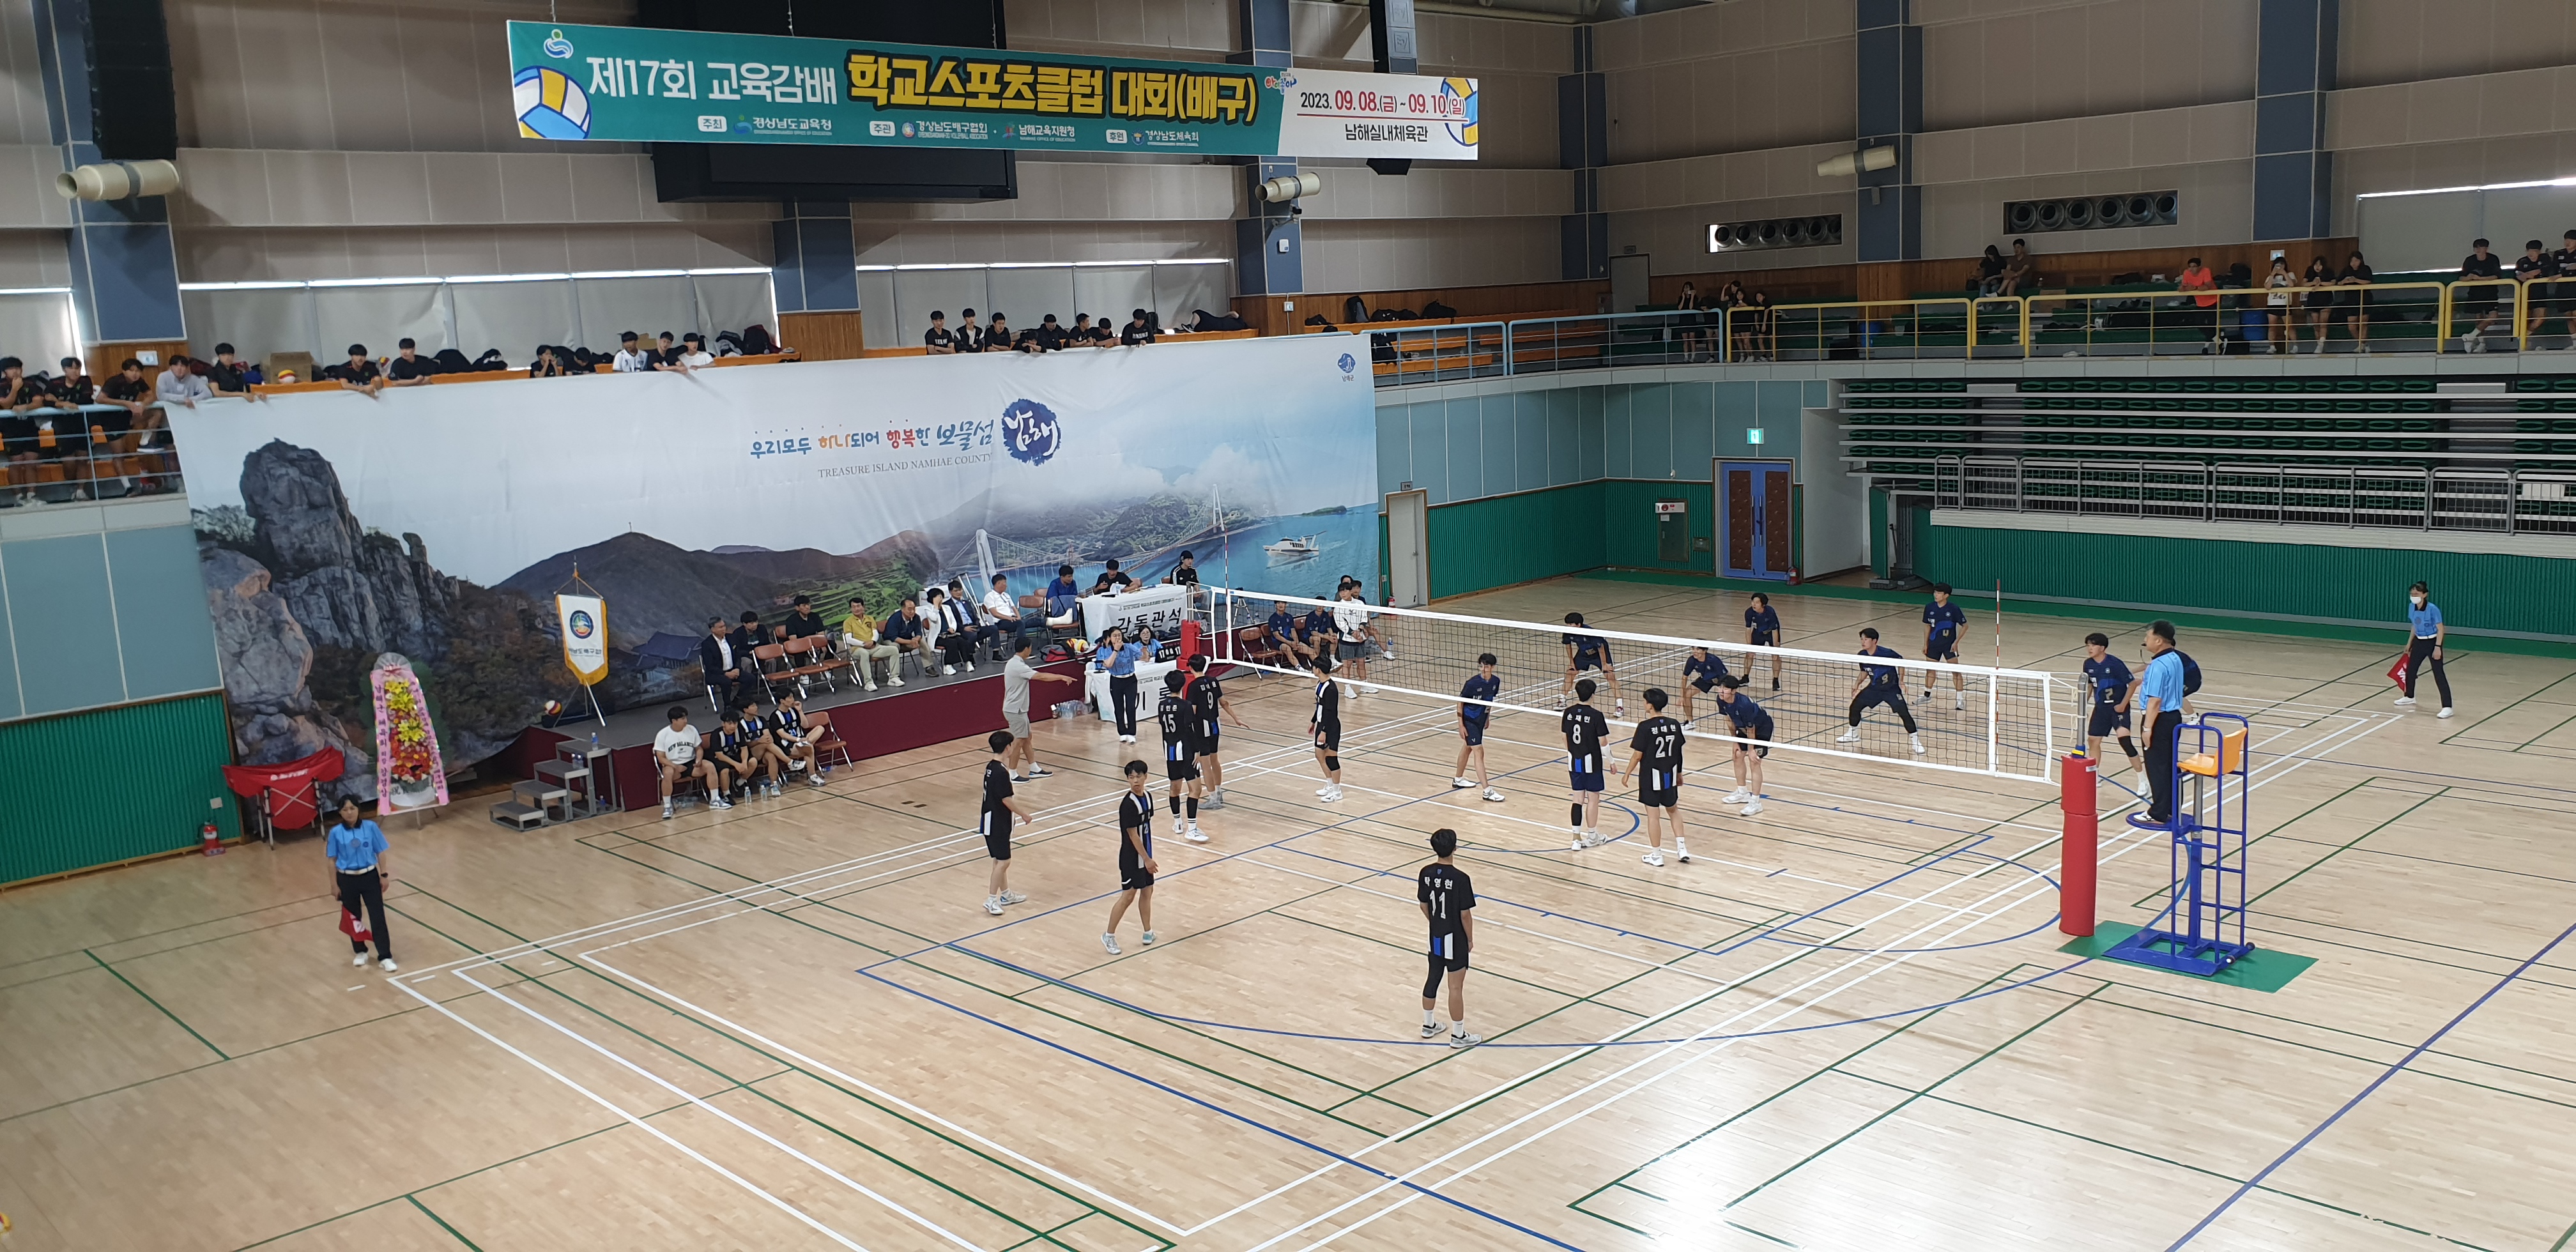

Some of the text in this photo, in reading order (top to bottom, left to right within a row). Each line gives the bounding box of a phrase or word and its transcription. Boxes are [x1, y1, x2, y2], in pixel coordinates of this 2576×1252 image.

[586, 54, 1257, 122] 제17회 교육감배 학교스포츠클럽 대회(배구)
[1301, 92, 1332, 109] 2023.
[1335, 89, 1356, 111] 09.
[1359, 91, 1397, 113] 08.(금)
[1408, 94, 1428, 114] 09.
[1431, 95, 1466, 116] 10.(일)
[703, 118, 723, 130] 주최
[753, 117, 832, 130] 경상남도교육청
[873, 123, 891, 134] 주관
[916, 121, 988, 134] 경상남도배구협회
[1018, 124, 1075, 137] 남해교육지원청
[1345, 123, 1429, 142] 남해실내체육관
[1109, 132, 1124, 141] 후원
[1145, 130, 1199, 142] 경상남도체육회
[751, 420, 995, 459] 우리모두 하나되어 행복한 보물섬
[1004, 409, 1057, 457] 남해
[818, 452, 992, 478] TREASURE ISLAND NAMHAE COUNTY
[1207, 691, 1214, 710] 9
[1163, 714, 1176, 733] 15
[1572, 724, 1581, 744] 8
[1655, 735, 1675, 758] 27
[1429, 890, 1446, 919] 11
